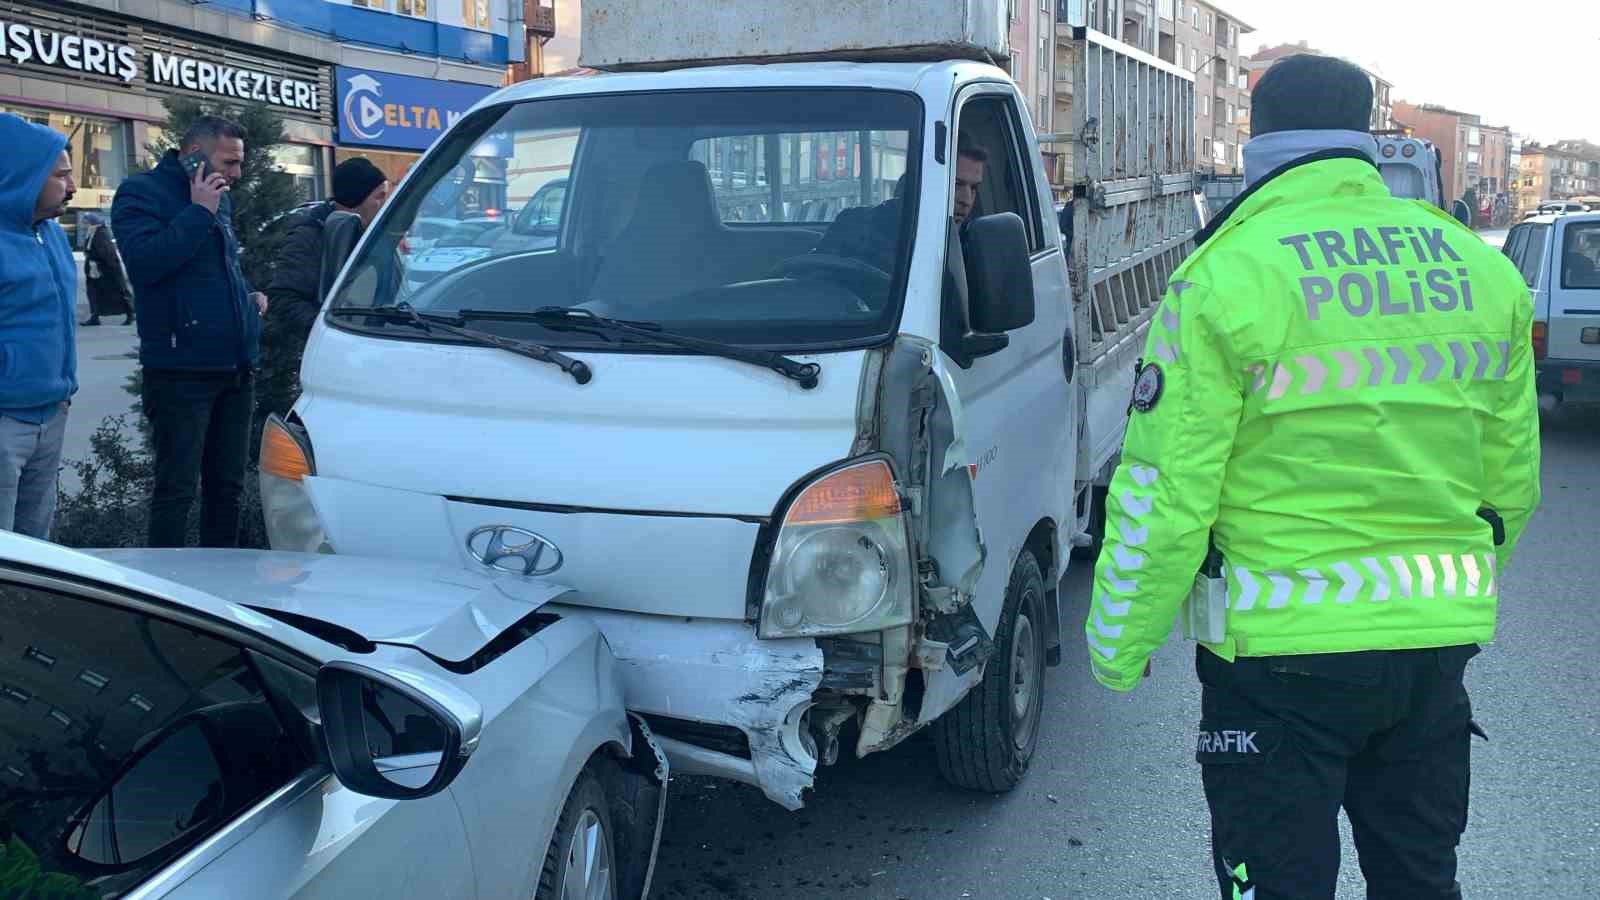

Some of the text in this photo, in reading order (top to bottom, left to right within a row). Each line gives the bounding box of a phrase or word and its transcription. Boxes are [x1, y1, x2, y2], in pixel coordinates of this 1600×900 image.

[152, 52, 318, 110] MERKEZLERİ
[1278, 226, 1463, 271] TRAFİK
[1298, 267, 1474, 321] POLİSİ
